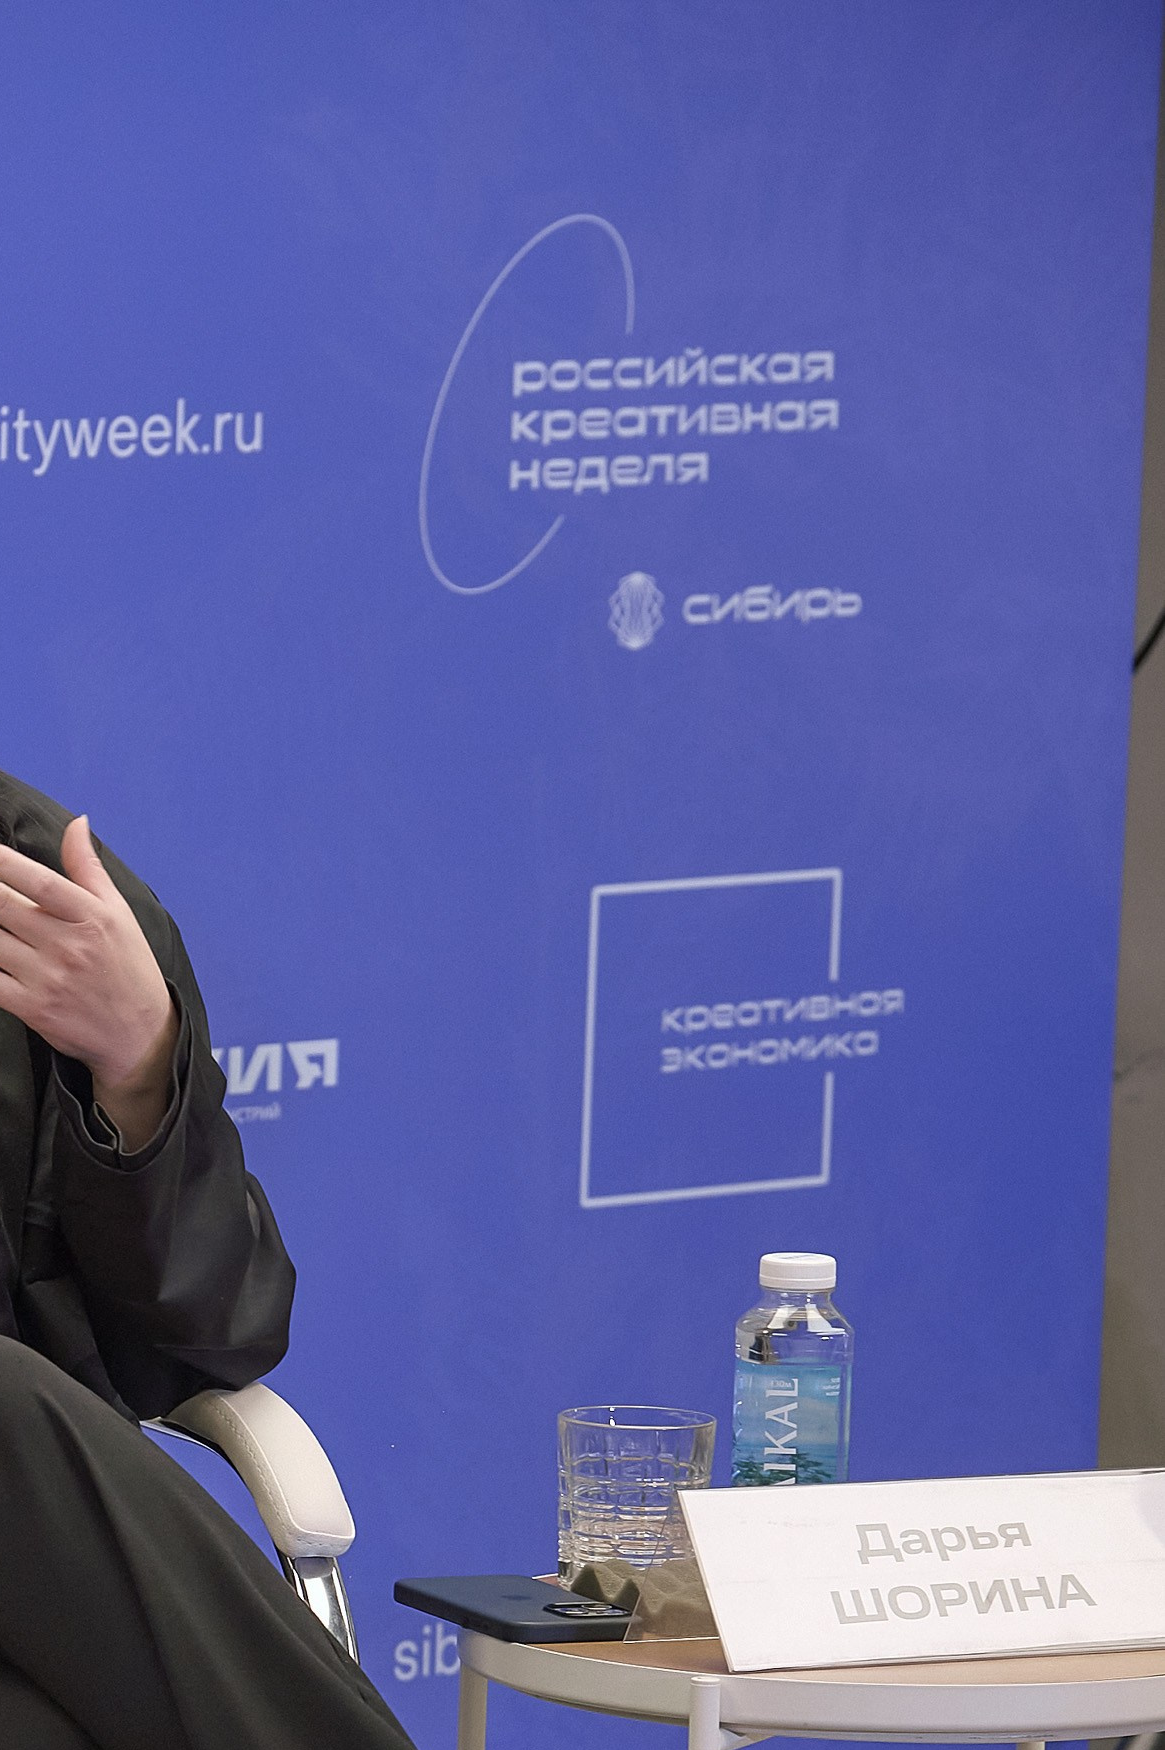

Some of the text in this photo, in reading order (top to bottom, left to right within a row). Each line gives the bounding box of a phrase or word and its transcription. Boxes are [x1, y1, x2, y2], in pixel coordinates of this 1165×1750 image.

[512, 347, 835, 397] российская
[511, 399, 840, 446] креативная
[509, 452, 710, 494] неделя
[682, 585, 863, 624] сибирь
[213, 1039, 339, 1095] ИЯ
[855, 1522, 1033, 1565] Дарья
[830, 1573, 1099, 1625] ШОРИНА
